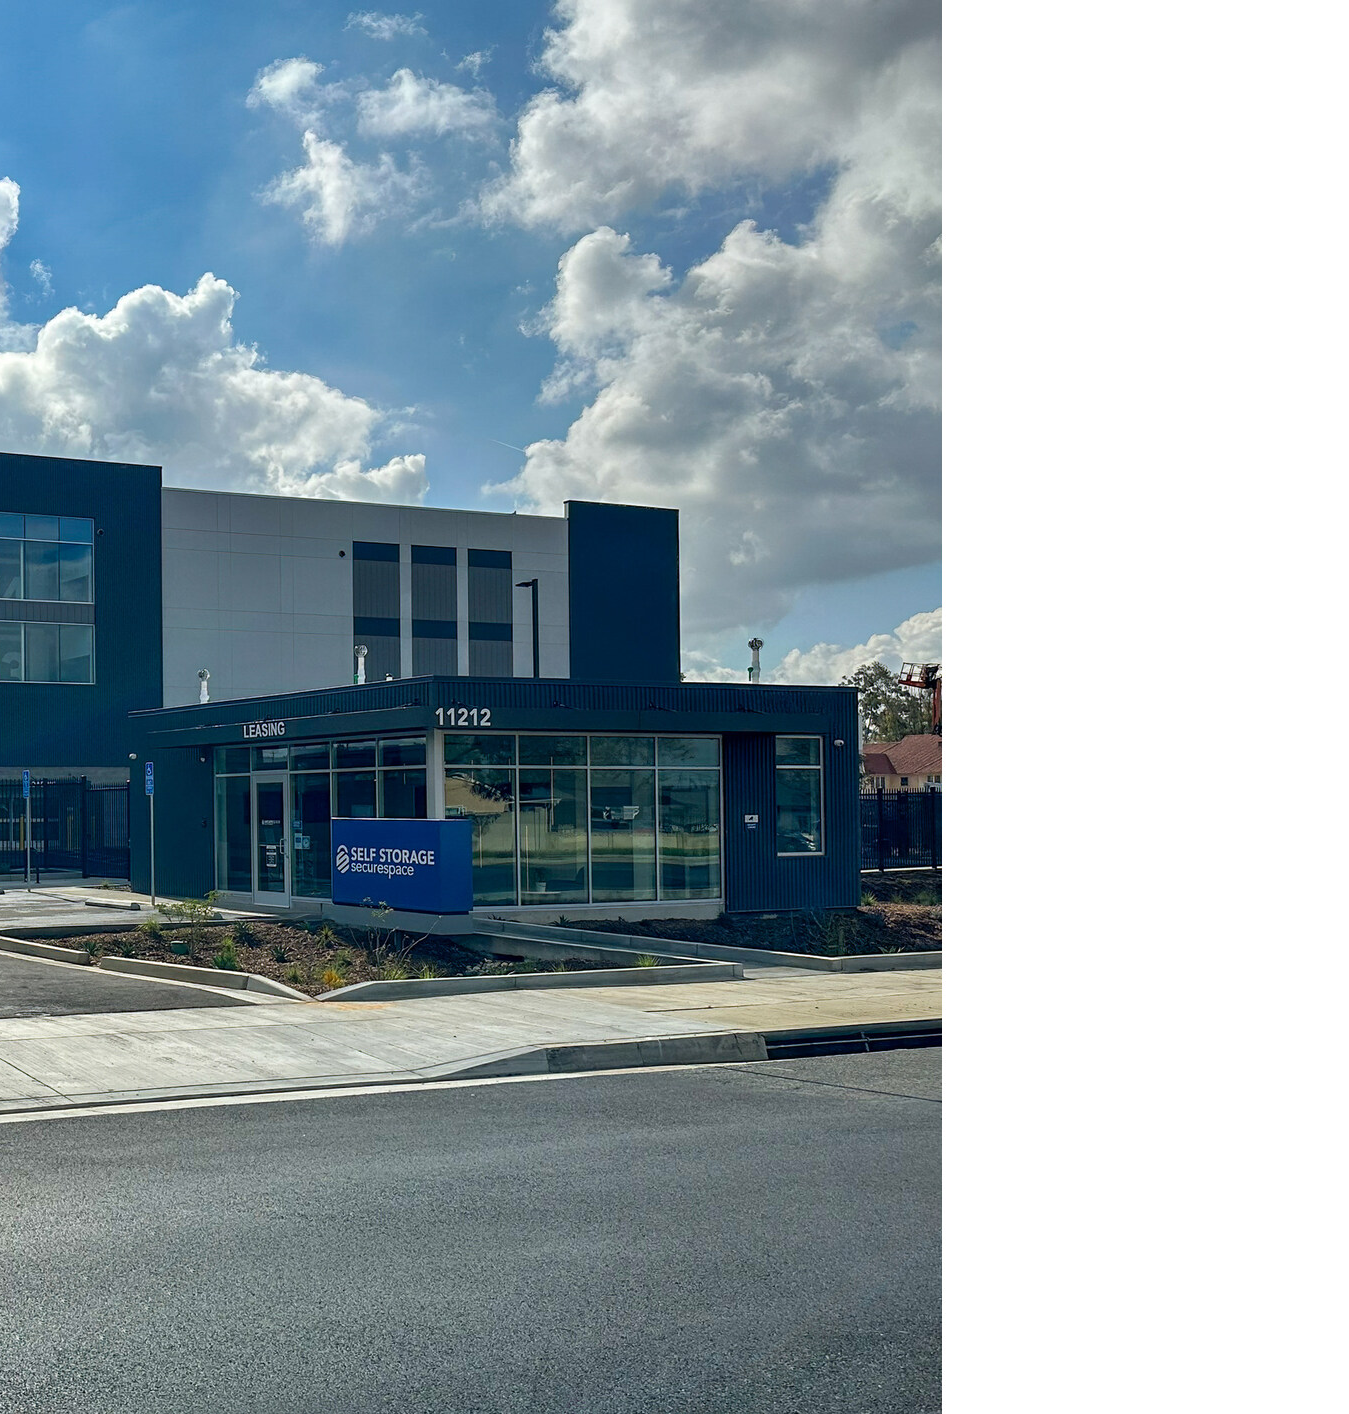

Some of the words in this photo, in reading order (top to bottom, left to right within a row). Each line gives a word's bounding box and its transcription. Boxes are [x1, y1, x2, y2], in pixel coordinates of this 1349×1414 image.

[435, 707, 492, 727] 11212
[243, 721, 286, 739] LEASING
[351, 847, 376, 861] SELF
[379, 848, 435, 865] STORAGE
[350, 862, 414, 879] securespace
